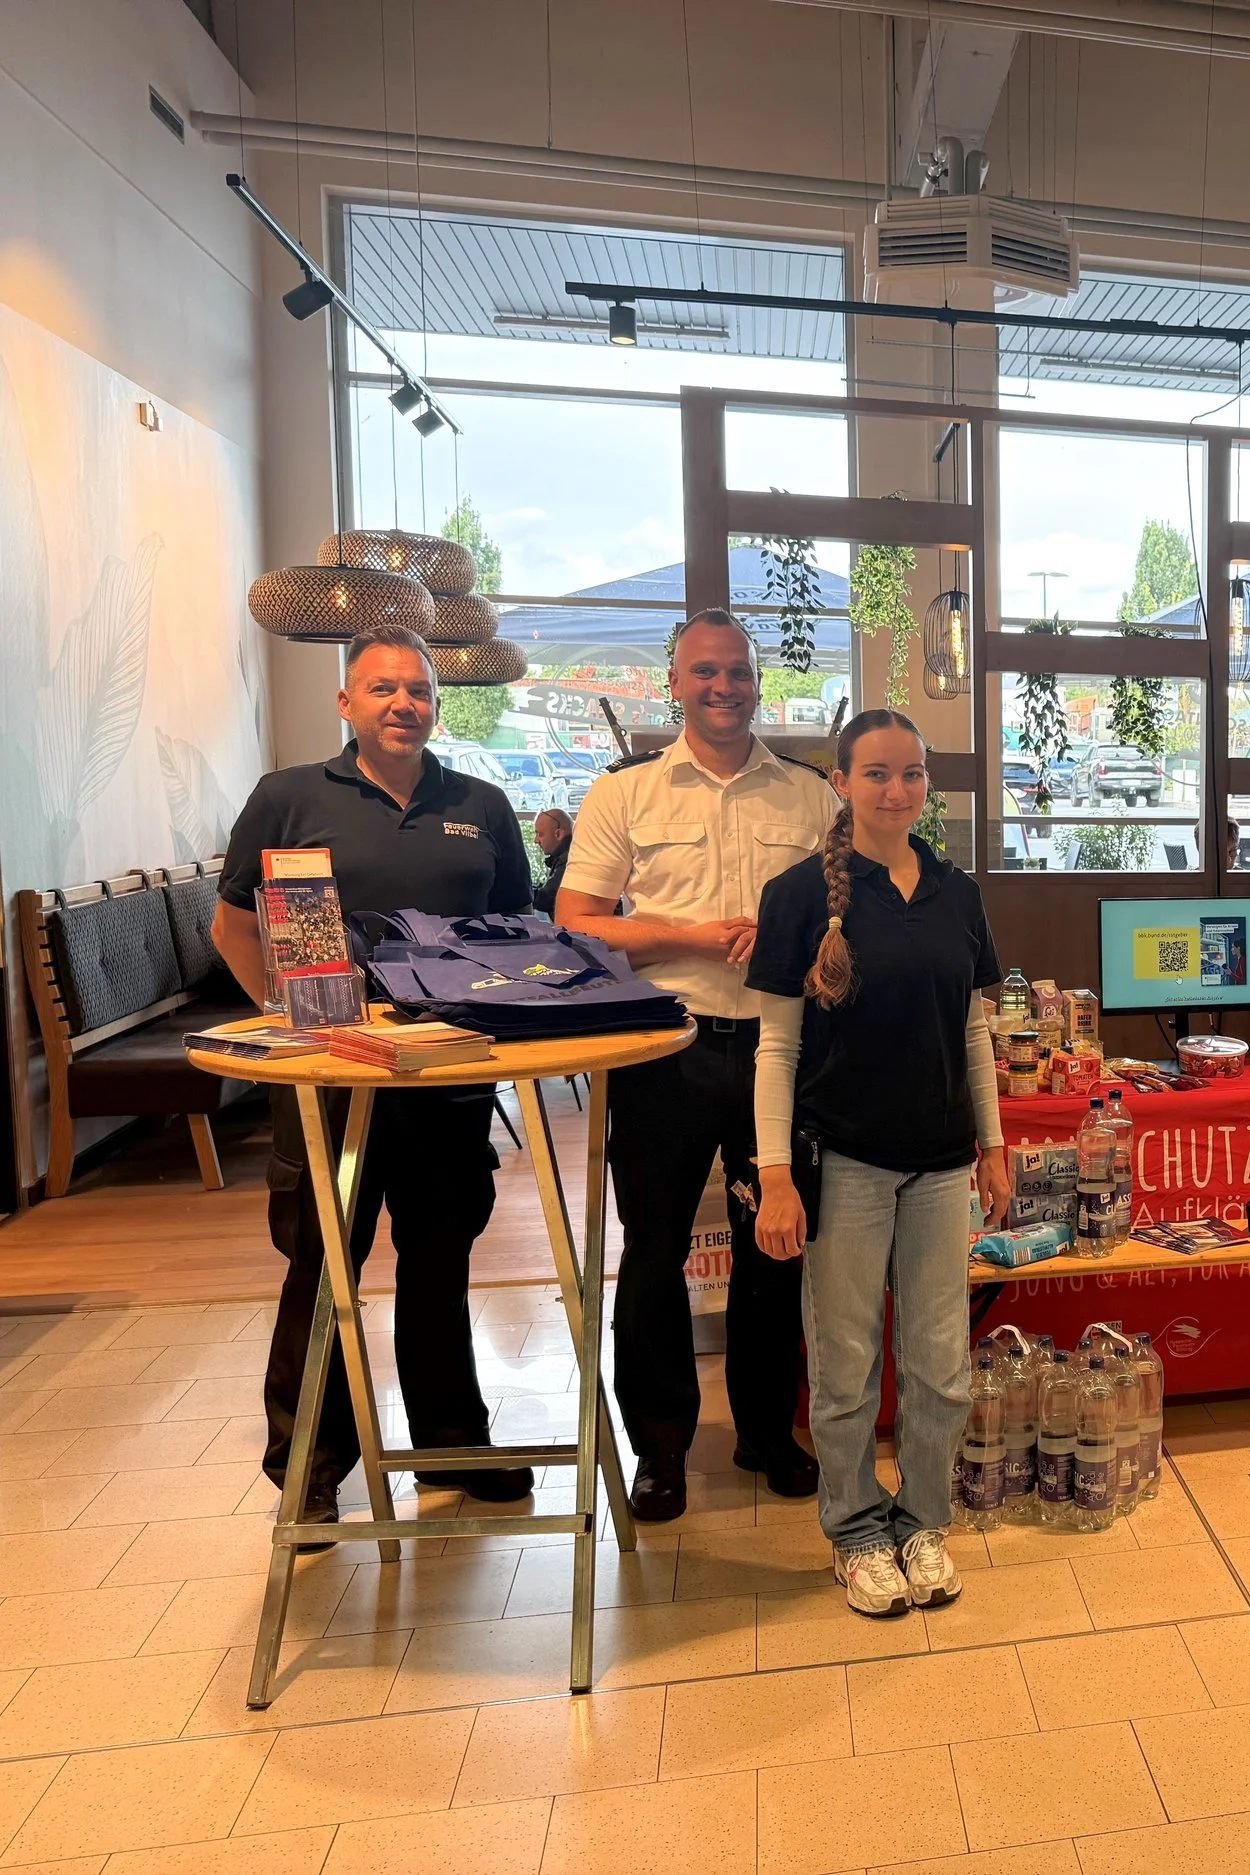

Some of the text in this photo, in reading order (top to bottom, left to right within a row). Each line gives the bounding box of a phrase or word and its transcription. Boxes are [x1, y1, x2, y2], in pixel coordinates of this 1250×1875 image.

[1025, 1153, 1040, 1169] ja!
[1048, 1162, 1080, 1176] Classic
[1019, 1200, 1034, 1214] ja!
[1042, 1208, 1076, 1222] Classic
